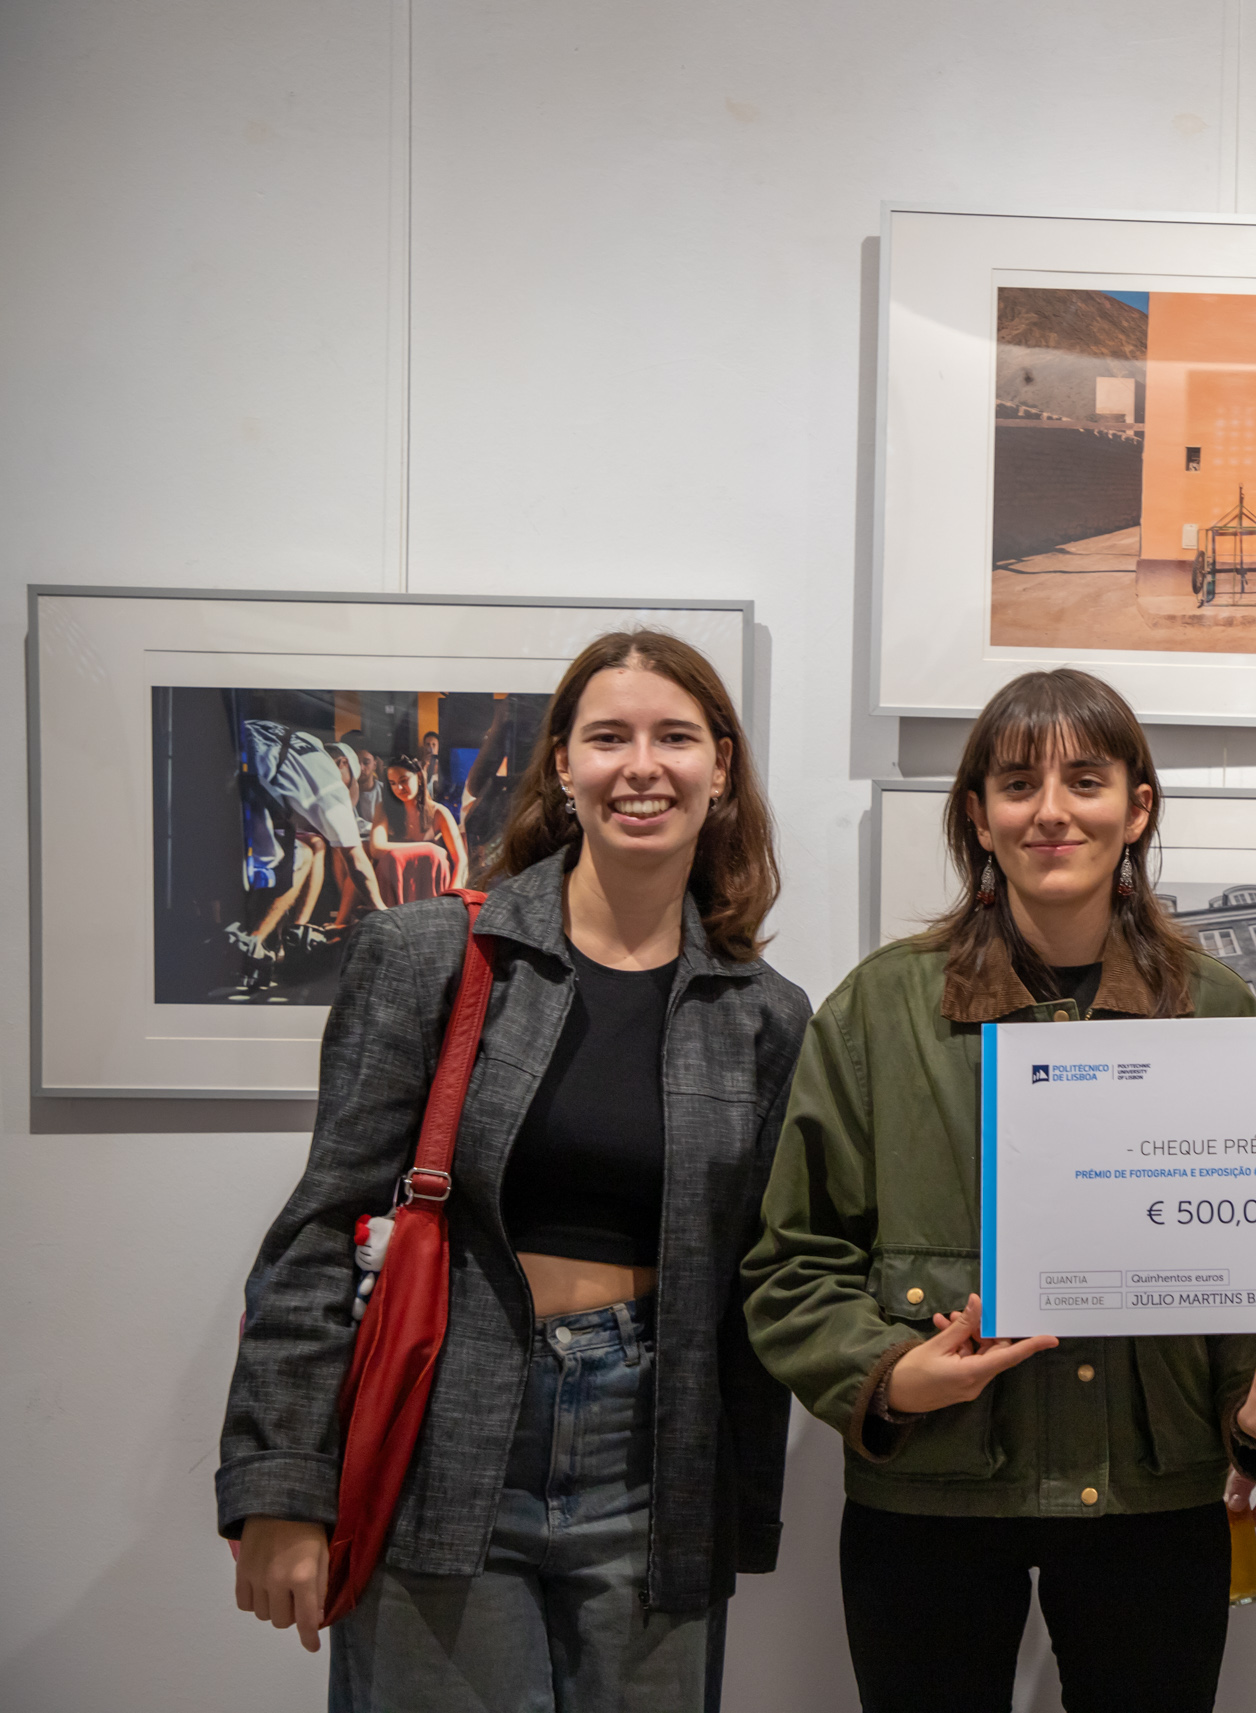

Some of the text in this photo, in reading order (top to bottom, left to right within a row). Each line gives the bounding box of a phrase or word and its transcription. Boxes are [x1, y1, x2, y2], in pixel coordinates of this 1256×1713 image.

[1052, 1064, 1109, 1073] POLITÉCNICO
[1052, 1073, 1098, 1082] DE LISBOA
[1140, 1139, 1218, 1156] CHEQUE
[1075, 1168, 1112, 1179] PRÉMIO
[1114, 1169, 1127, 1178] DE
[1129, 1168, 1188, 1178] FOTOGRAFIA
[1191, 1168, 1197, 1177] E
[1199, 1166, 1252, 1179] EXPOSIÇÃO
[1147, 1201, 1165, 1225] €
[1045, 1275, 1088, 1285] QUANTIA
[1131, 1273, 1224, 1284] Quinhentos euros
[1045, 1295, 1104, 1306] À ORDEM DE
[1131, 1291, 1174, 1306] JÚLIO
[1179, 1292, 1243, 1305] MARTINS
